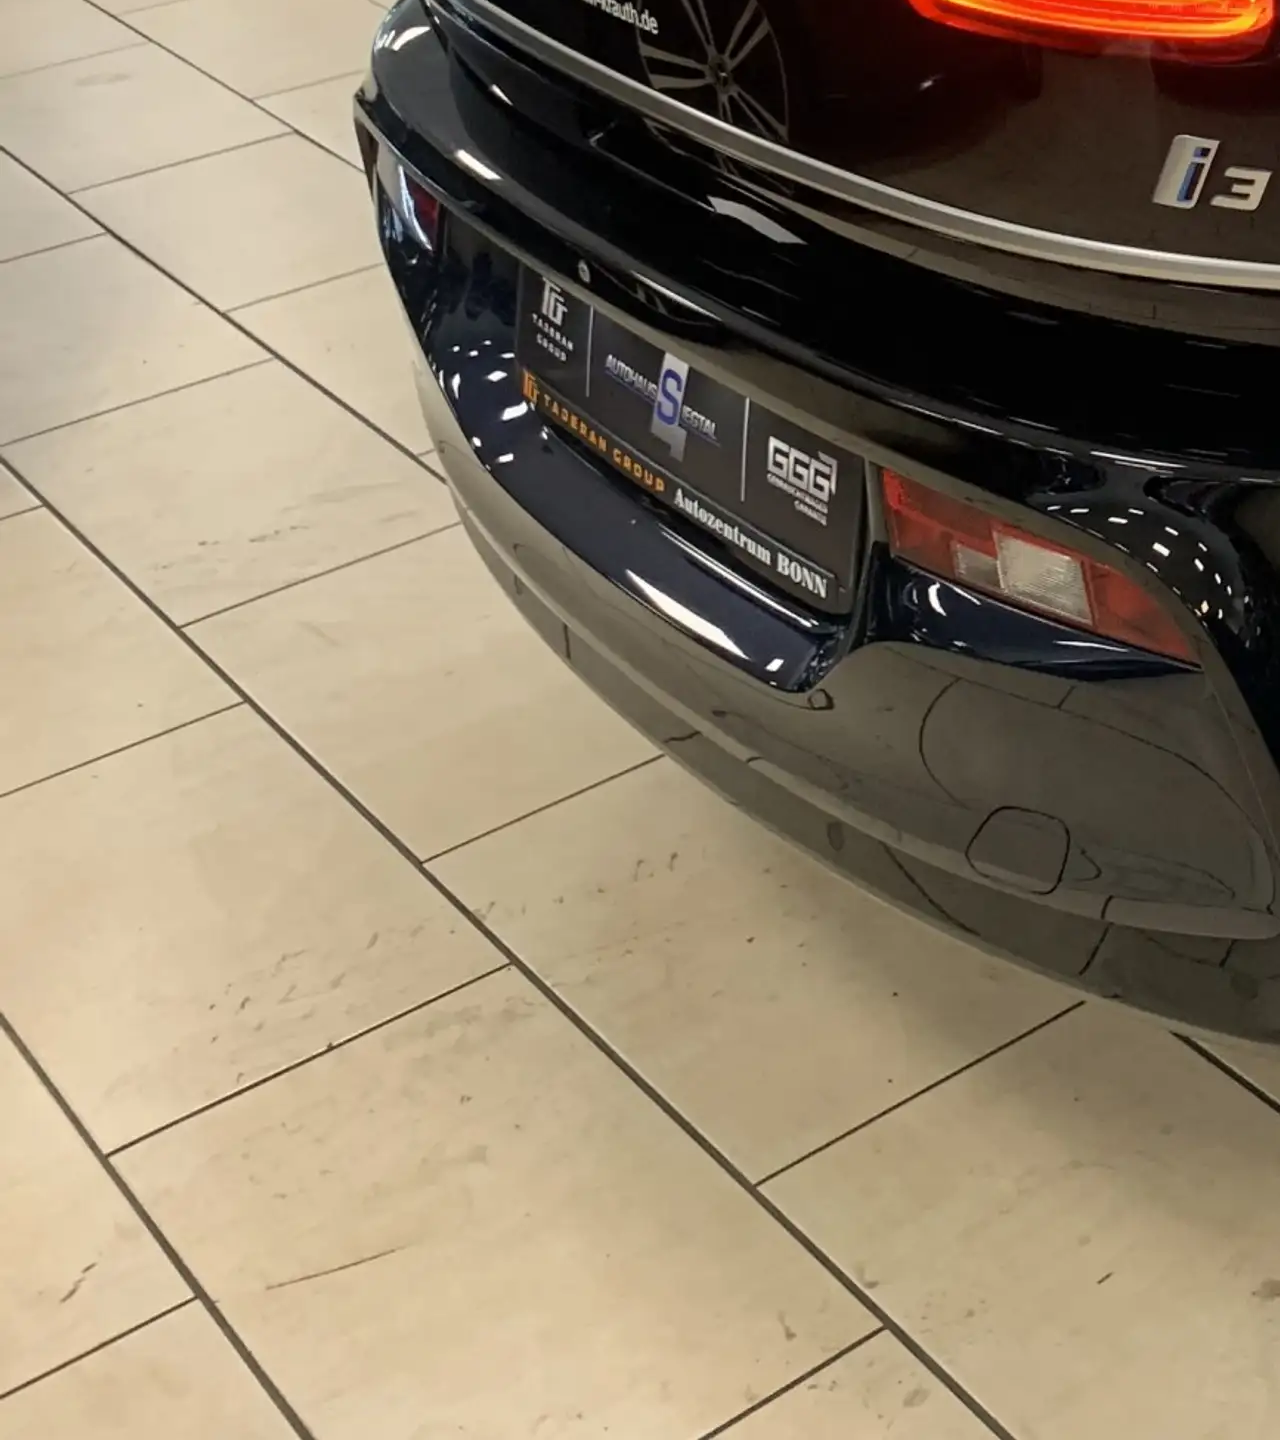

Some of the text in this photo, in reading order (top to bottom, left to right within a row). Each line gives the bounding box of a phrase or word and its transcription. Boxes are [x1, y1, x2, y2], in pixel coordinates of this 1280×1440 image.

[1152, 134, 1274, 211] i3
[605, 354, 658, 401] AUTOHAUS
[673, 487, 772, 566] Autozentrum
[776, 551, 828, 600] BONN
